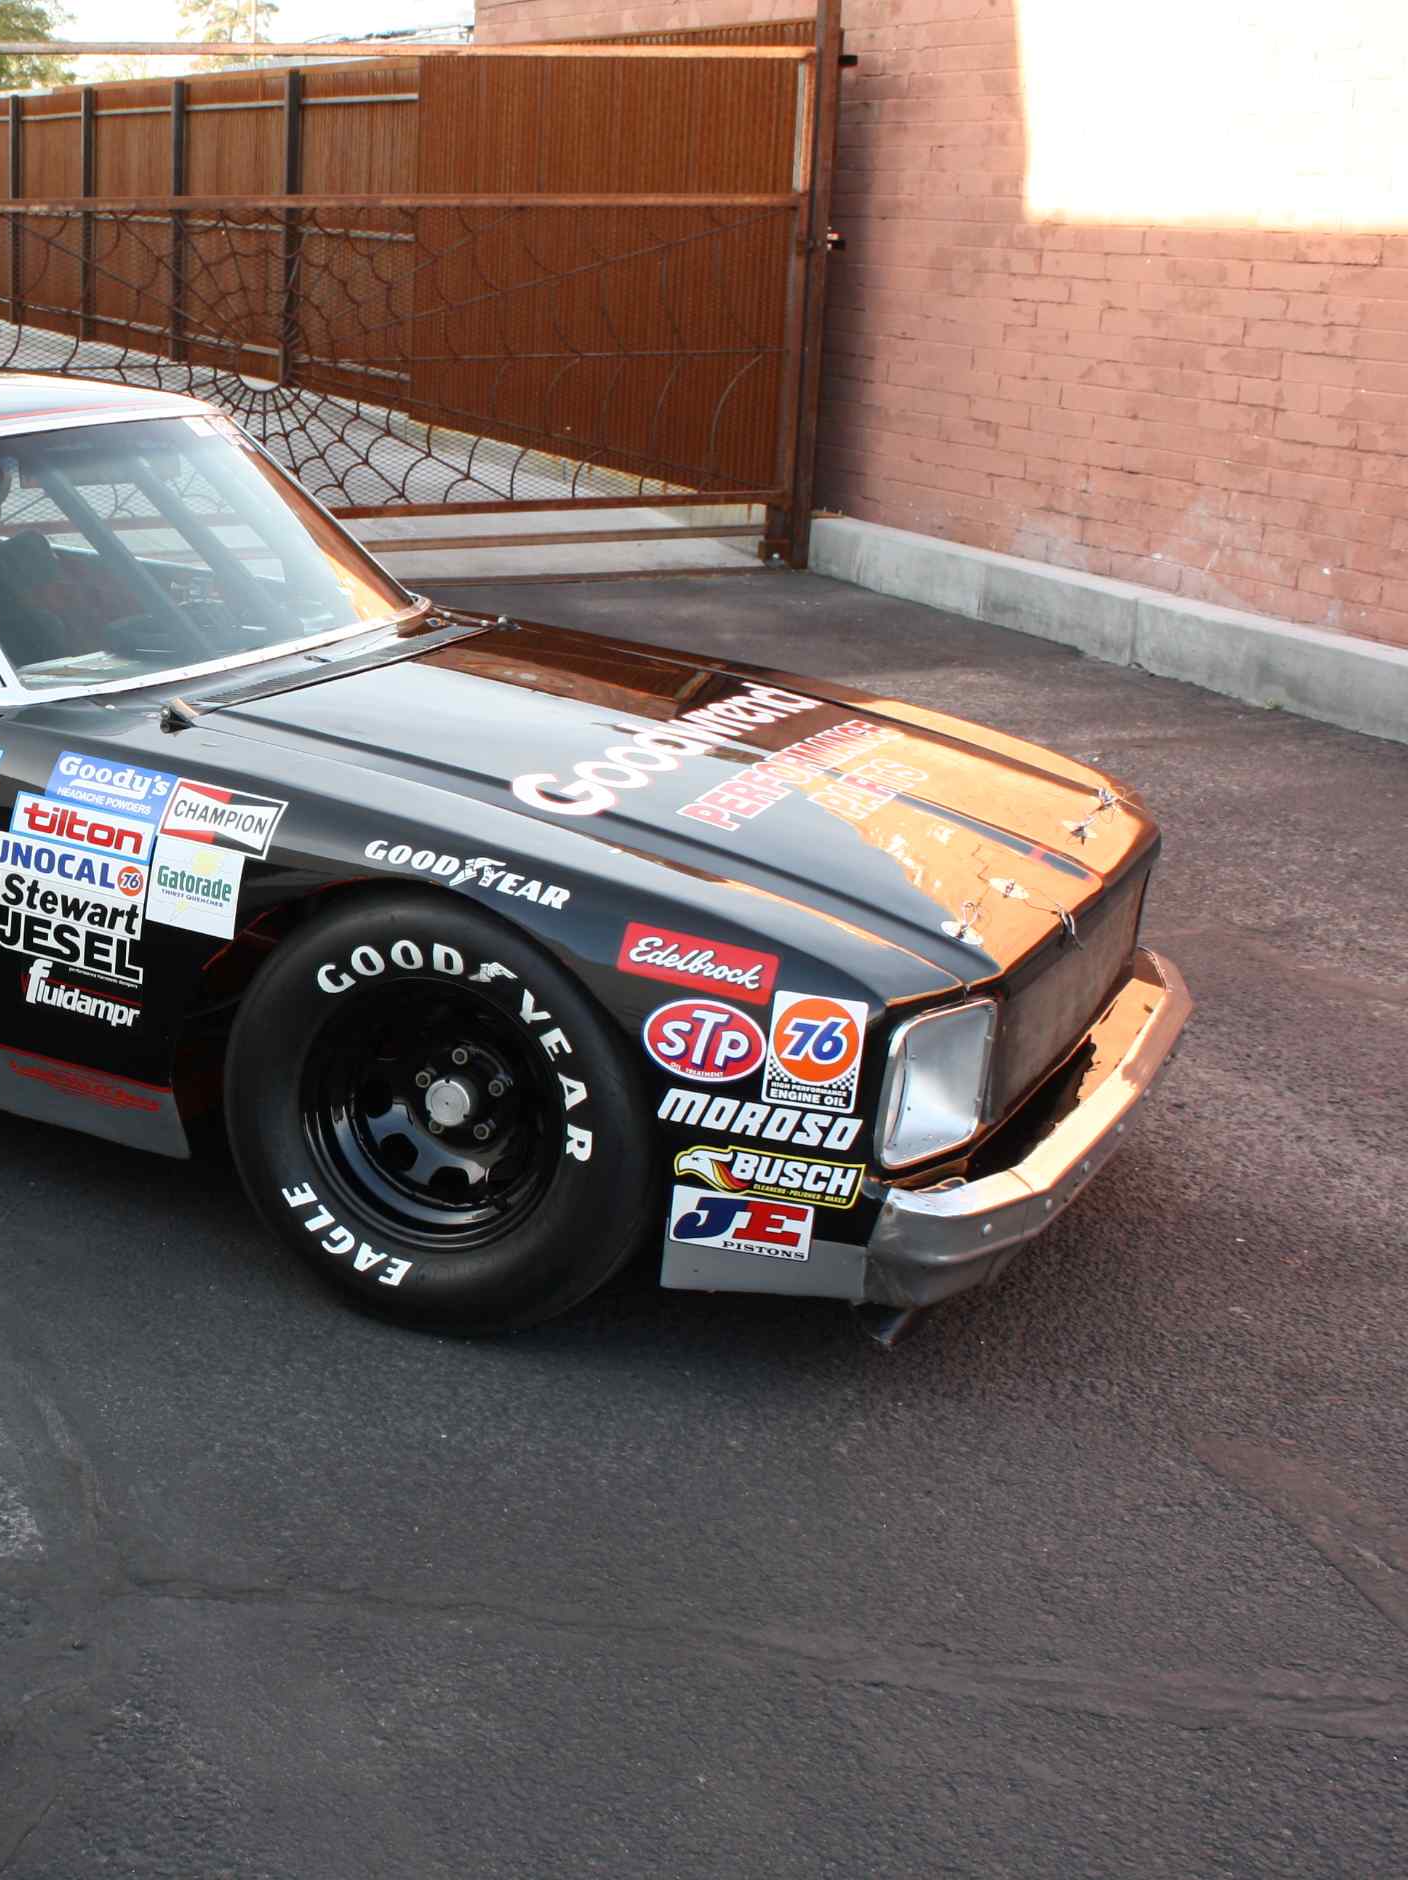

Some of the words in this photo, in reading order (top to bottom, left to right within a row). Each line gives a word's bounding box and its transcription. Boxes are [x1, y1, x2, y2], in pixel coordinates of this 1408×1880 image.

[56, 785, 106, 805] HEADACHE
[107, 797, 151, 815] POWDERS
[59, 756, 170, 796] Goody's
[675, 719, 904, 832] PERFORMANCE
[24, 802, 143, 855] tilton
[174, 799, 269, 836] CHAMPION
[119, 873, 140, 889] 76
[157, 865, 232, 903] Gatorade
[364, 839, 571, 910] GOODYEAR
[1, 873, 139, 935] Stewart
[628, 936, 764, 990] Edelbrock
[25, 958, 141, 1028] fluidampr
[316, 938, 593, 1163] GOODYEAR
[656, 1009, 749, 1068] STP
[779, 1016, 851, 1065] 76
[770, 1088, 822, 1104] ENGINE
[823, 1096, 847, 1107] OIL
[771, 1081, 791, 1090] HIGH
[791, 1085, 848, 1097] PERFORMANCE
[658, 1087, 864, 1151] MOROSO
[730, 1151, 858, 1197] BUSCH
[281, 1182, 414, 1287] EAGLE
[673, 1196, 809, 1248] JE
[722, 1240, 806, 1260] PISTONS
